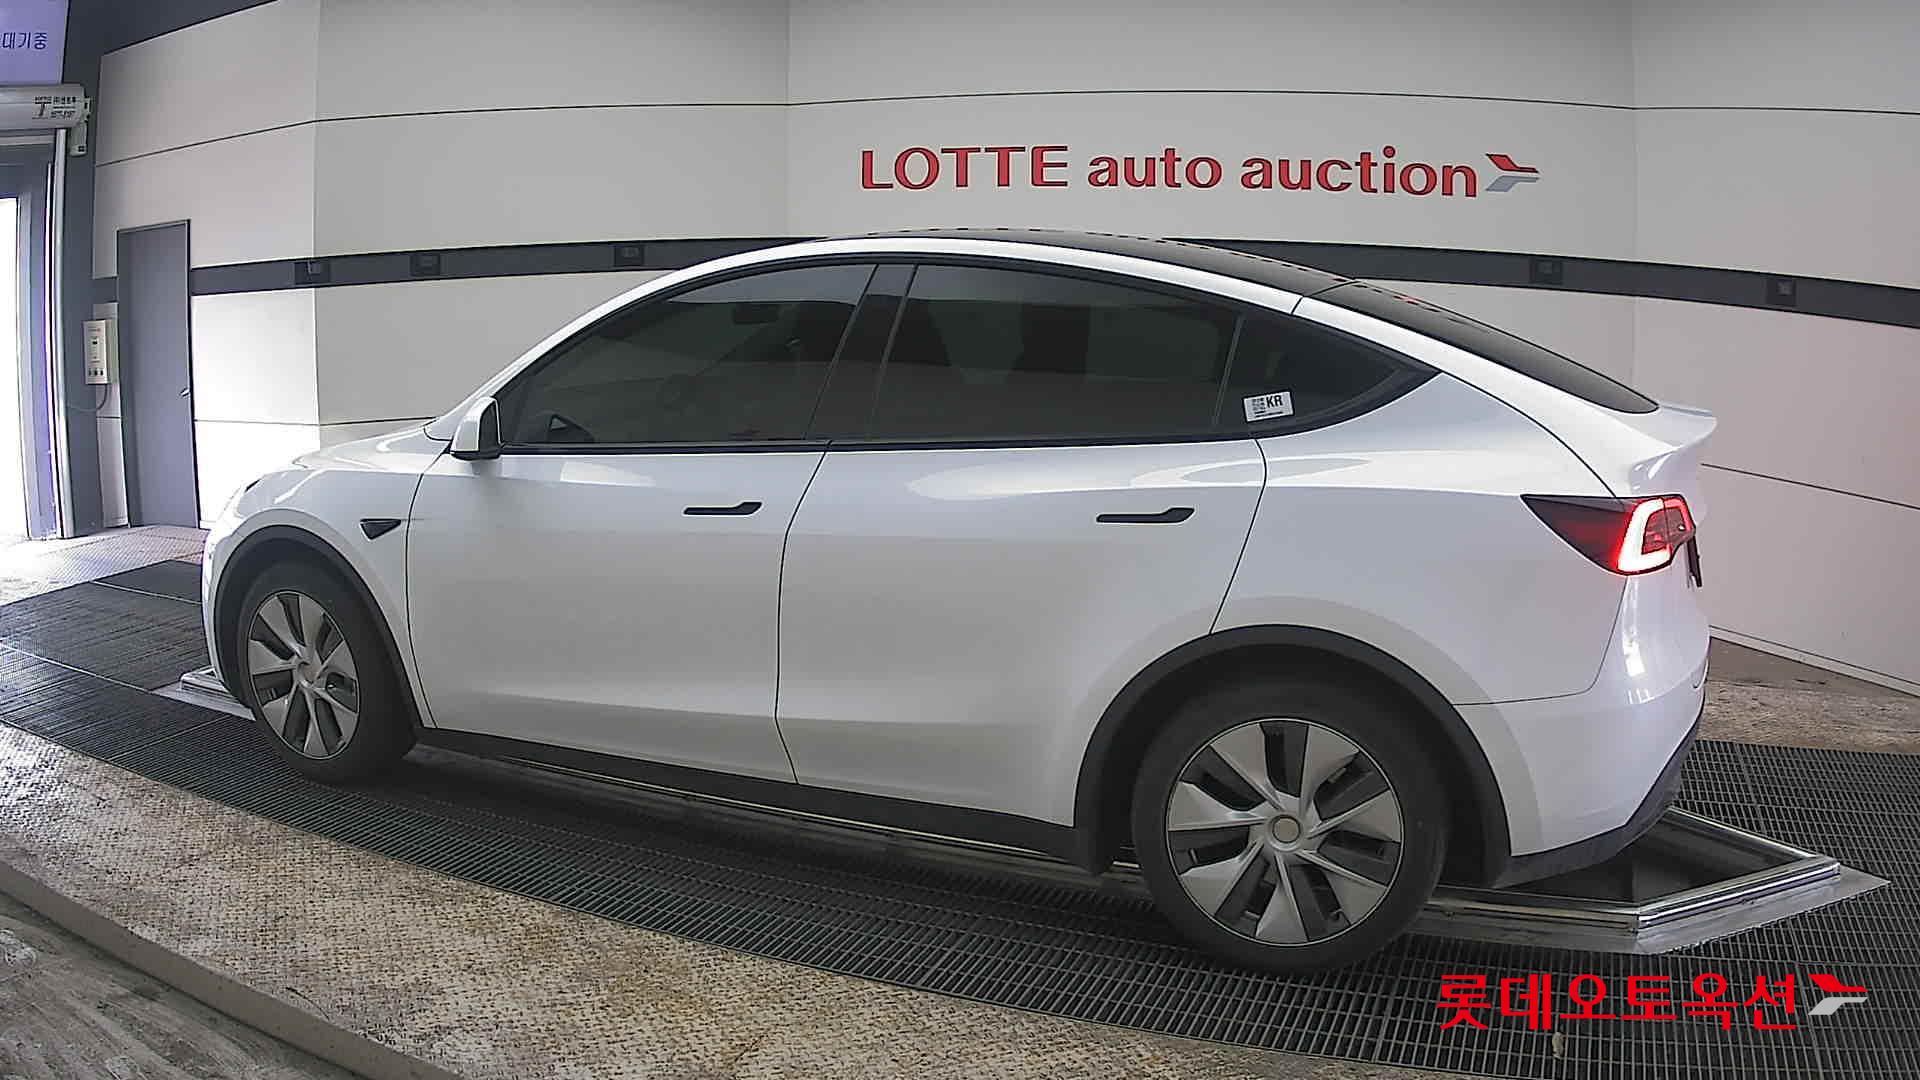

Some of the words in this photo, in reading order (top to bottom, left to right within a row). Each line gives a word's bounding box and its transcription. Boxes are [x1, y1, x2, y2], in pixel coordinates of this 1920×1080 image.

[861, 145, 1068, 189] LOTTE
[1087, 149, 1223, 189] auto
[1241, 145, 1477, 198] auction
[1266, 395, 1282, 408] KR
